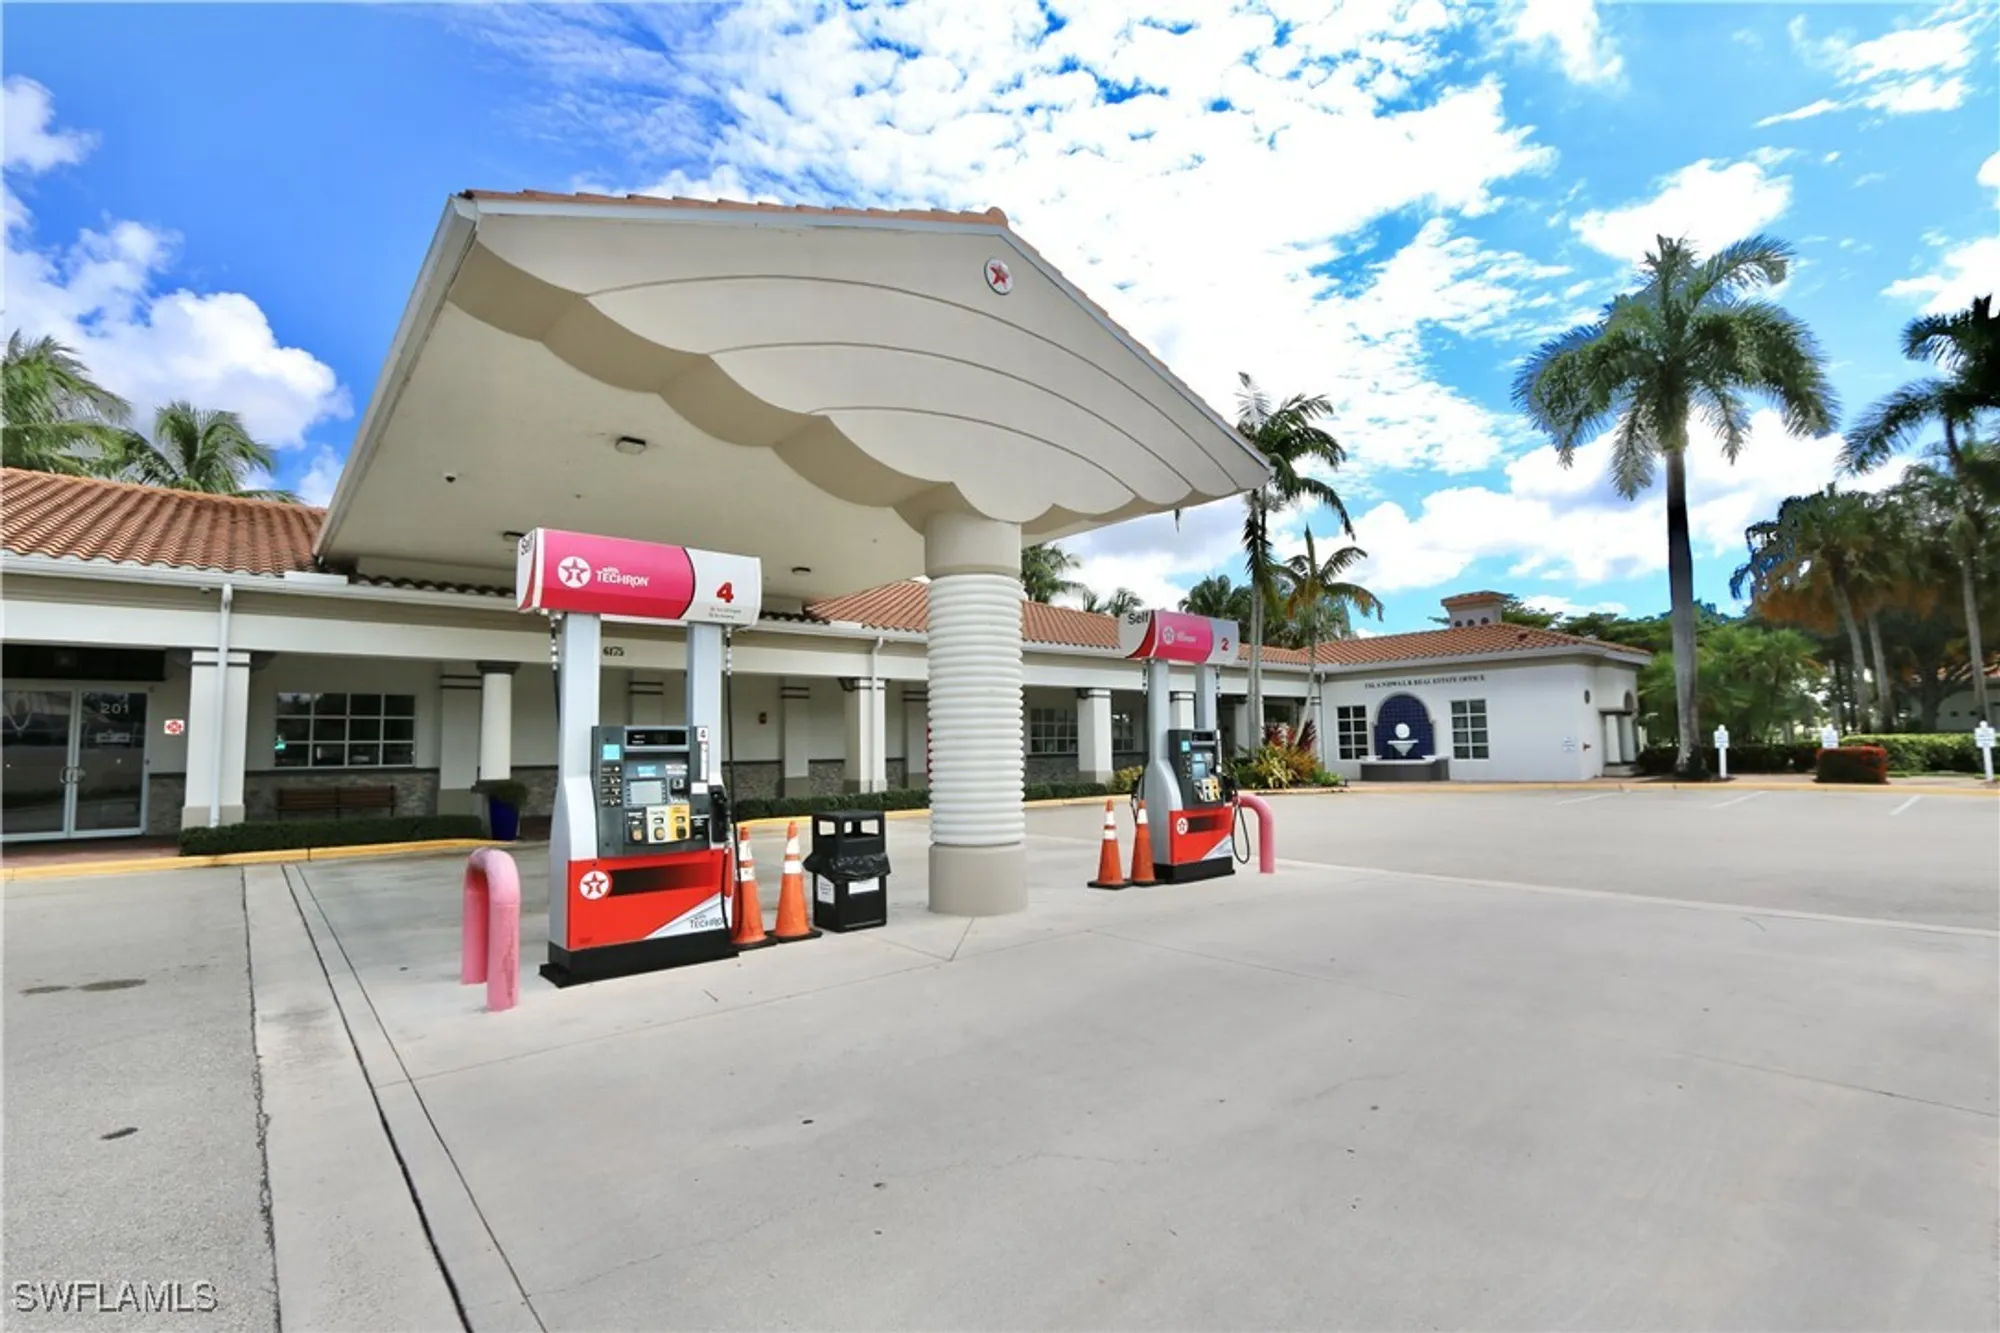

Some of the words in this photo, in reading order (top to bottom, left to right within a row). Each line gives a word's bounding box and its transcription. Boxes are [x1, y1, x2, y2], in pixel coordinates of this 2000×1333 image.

[596, 570, 650, 588] TECHRON
[716, 581, 734, 604] 4
[1128, 612, 1149, 625] Self
[602, 645, 625, 657] 6175
[1221, 637, 1230, 652] 2
[101, 703, 129, 715] 201
